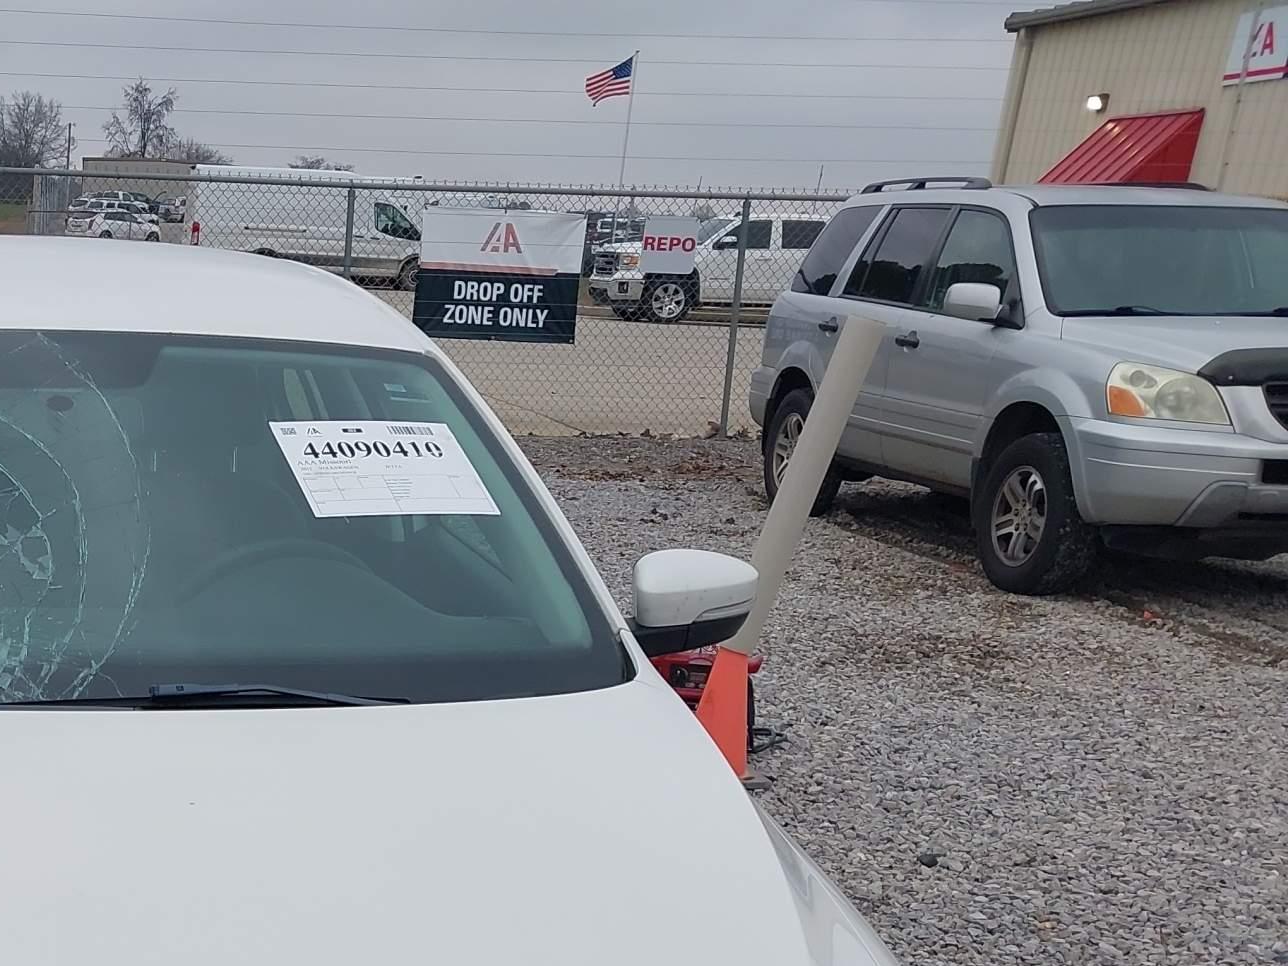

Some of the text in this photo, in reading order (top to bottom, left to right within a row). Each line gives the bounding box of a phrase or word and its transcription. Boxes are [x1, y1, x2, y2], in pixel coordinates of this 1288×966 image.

[643, 236, 696, 252] REPO
[453, 280, 544, 304] DROP OFF
[442, 304, 549, 329] ZONE ONLY
[303, 440, 444, 459] 44090410
